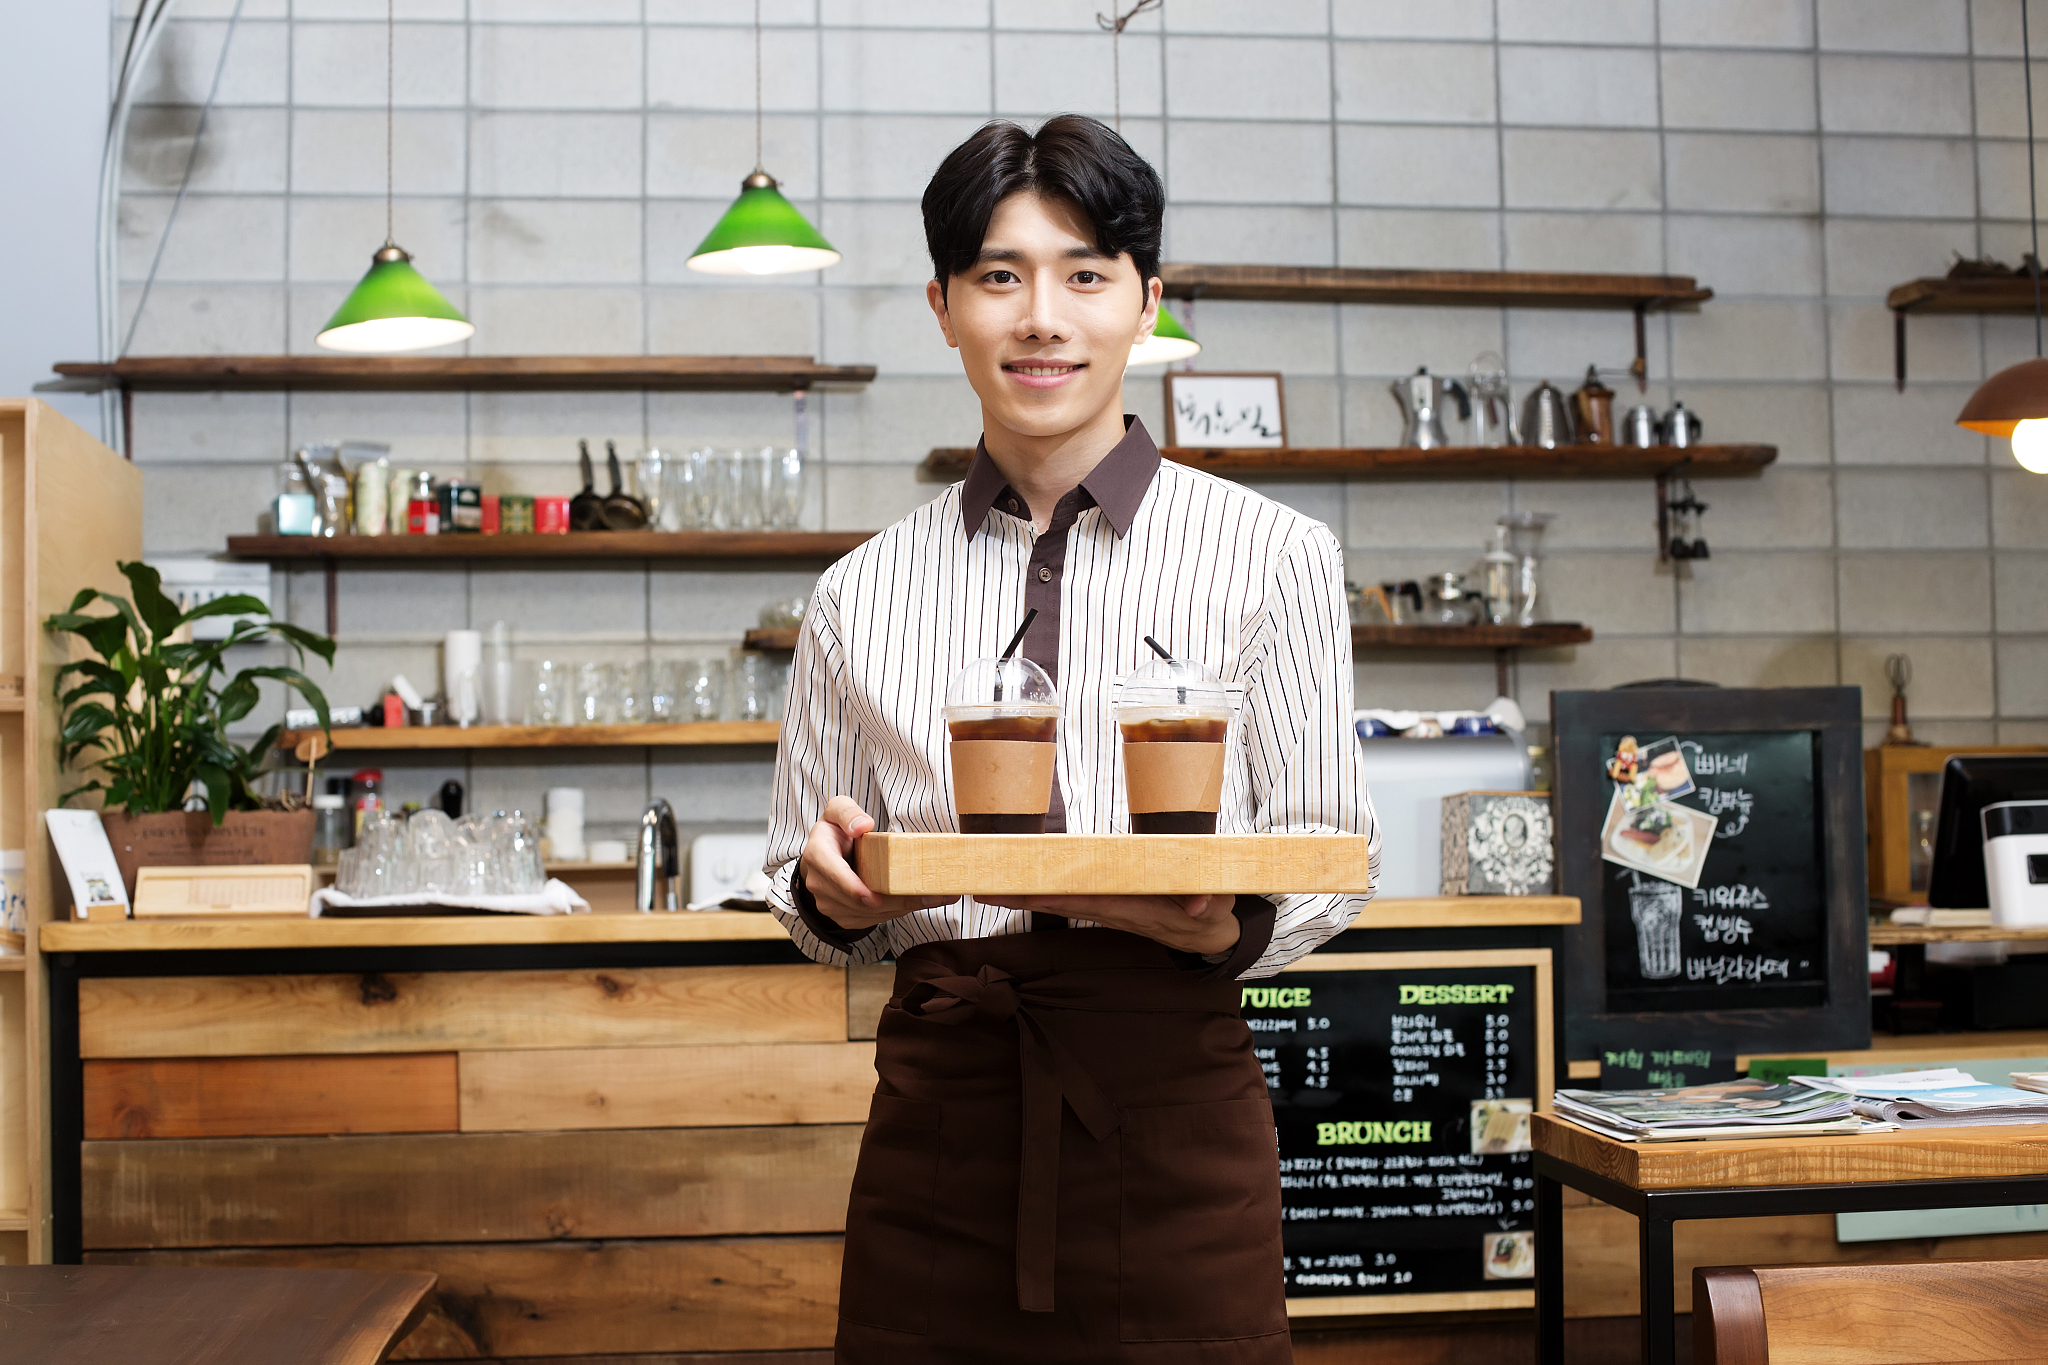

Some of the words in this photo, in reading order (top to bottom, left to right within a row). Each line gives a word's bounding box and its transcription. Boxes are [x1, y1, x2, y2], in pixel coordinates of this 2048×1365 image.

[1694, 752, 1748, 775] 빠네
[1693, 913, 1753, 945] 컵빙수
[1686, 953, 1789, 985] 바닐라라떼
[1240, 987, 1312, 1009] JUICE
[1399, 984, 1515, 1005] DESSERT
[1307, 1017, 1331, 1031] 5.0
[1485, 1014, 1510, 1029] 5.0
[1484, 1029, 1509, 1042] 5.0
[1306, 1060, 1330, 1074] 4.5
[1485, 1058, 1508, 1071] 2.5
[1304, 1075, 1330, 1089] 4.5
[1316, 1120, 1432, 1146] BRUNCH
